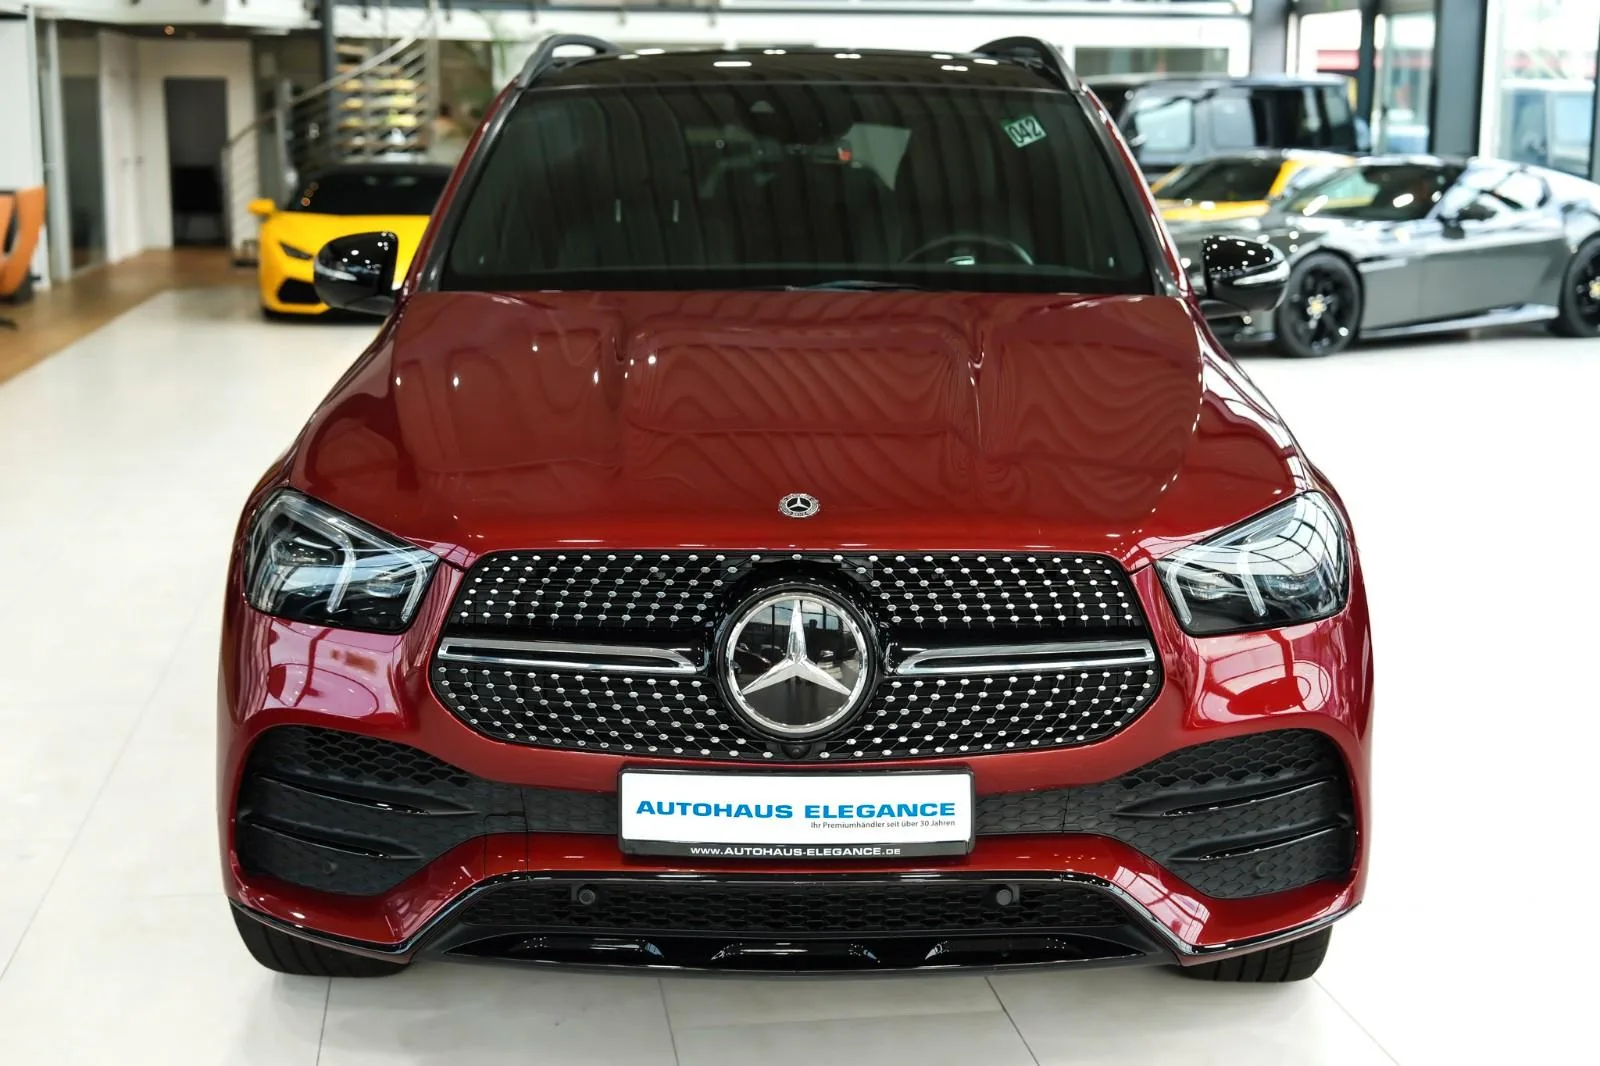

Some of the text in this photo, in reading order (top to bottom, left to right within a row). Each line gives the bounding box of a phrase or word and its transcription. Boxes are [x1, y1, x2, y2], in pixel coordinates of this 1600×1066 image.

[1009, 119, 1042, 144] 042
[636, 800, 955, 819] AUTOHAUS ELEGANCE
[811, 821, 821, 829] Ihr
[823, 820, 885, 829] Premiumhändler
[887, 819, 899, 828] seit
[901, 819, 918, 828] über
[931, 818, 955, 827] Jahren
[690, 847, 901, 856] www.AUTOHAUS-ELEGANCE.DE
